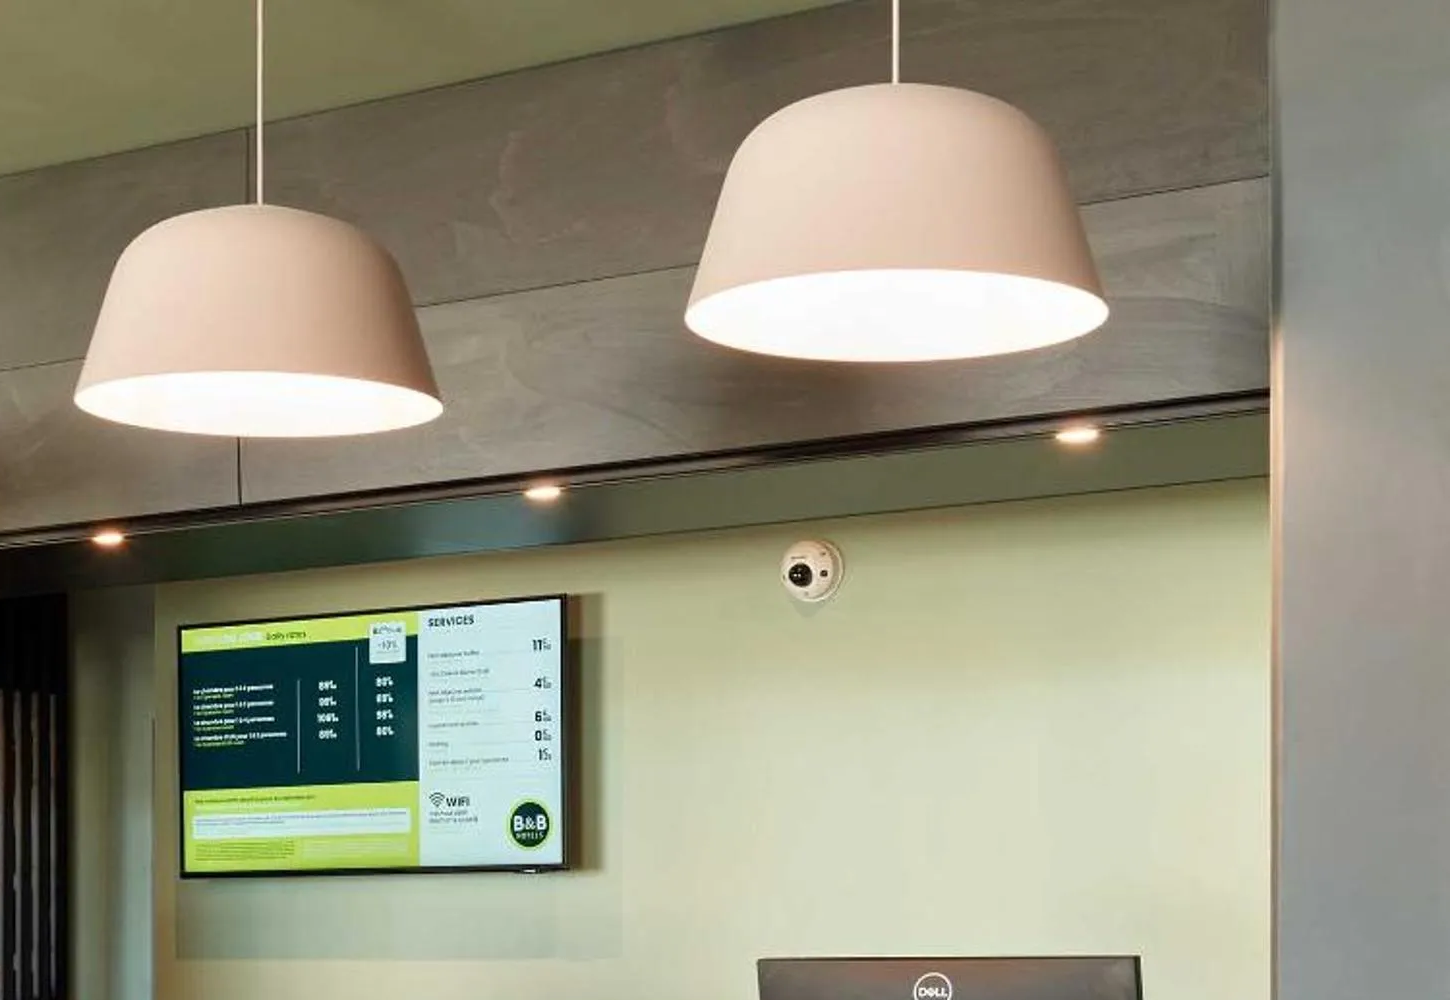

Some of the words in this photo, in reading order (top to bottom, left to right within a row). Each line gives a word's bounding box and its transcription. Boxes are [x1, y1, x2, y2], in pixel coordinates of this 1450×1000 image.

[428, 614, 475, 627] SERVICES
[513, 814, 548, 832] B&B
[918, 987, 948, 998] DELL
